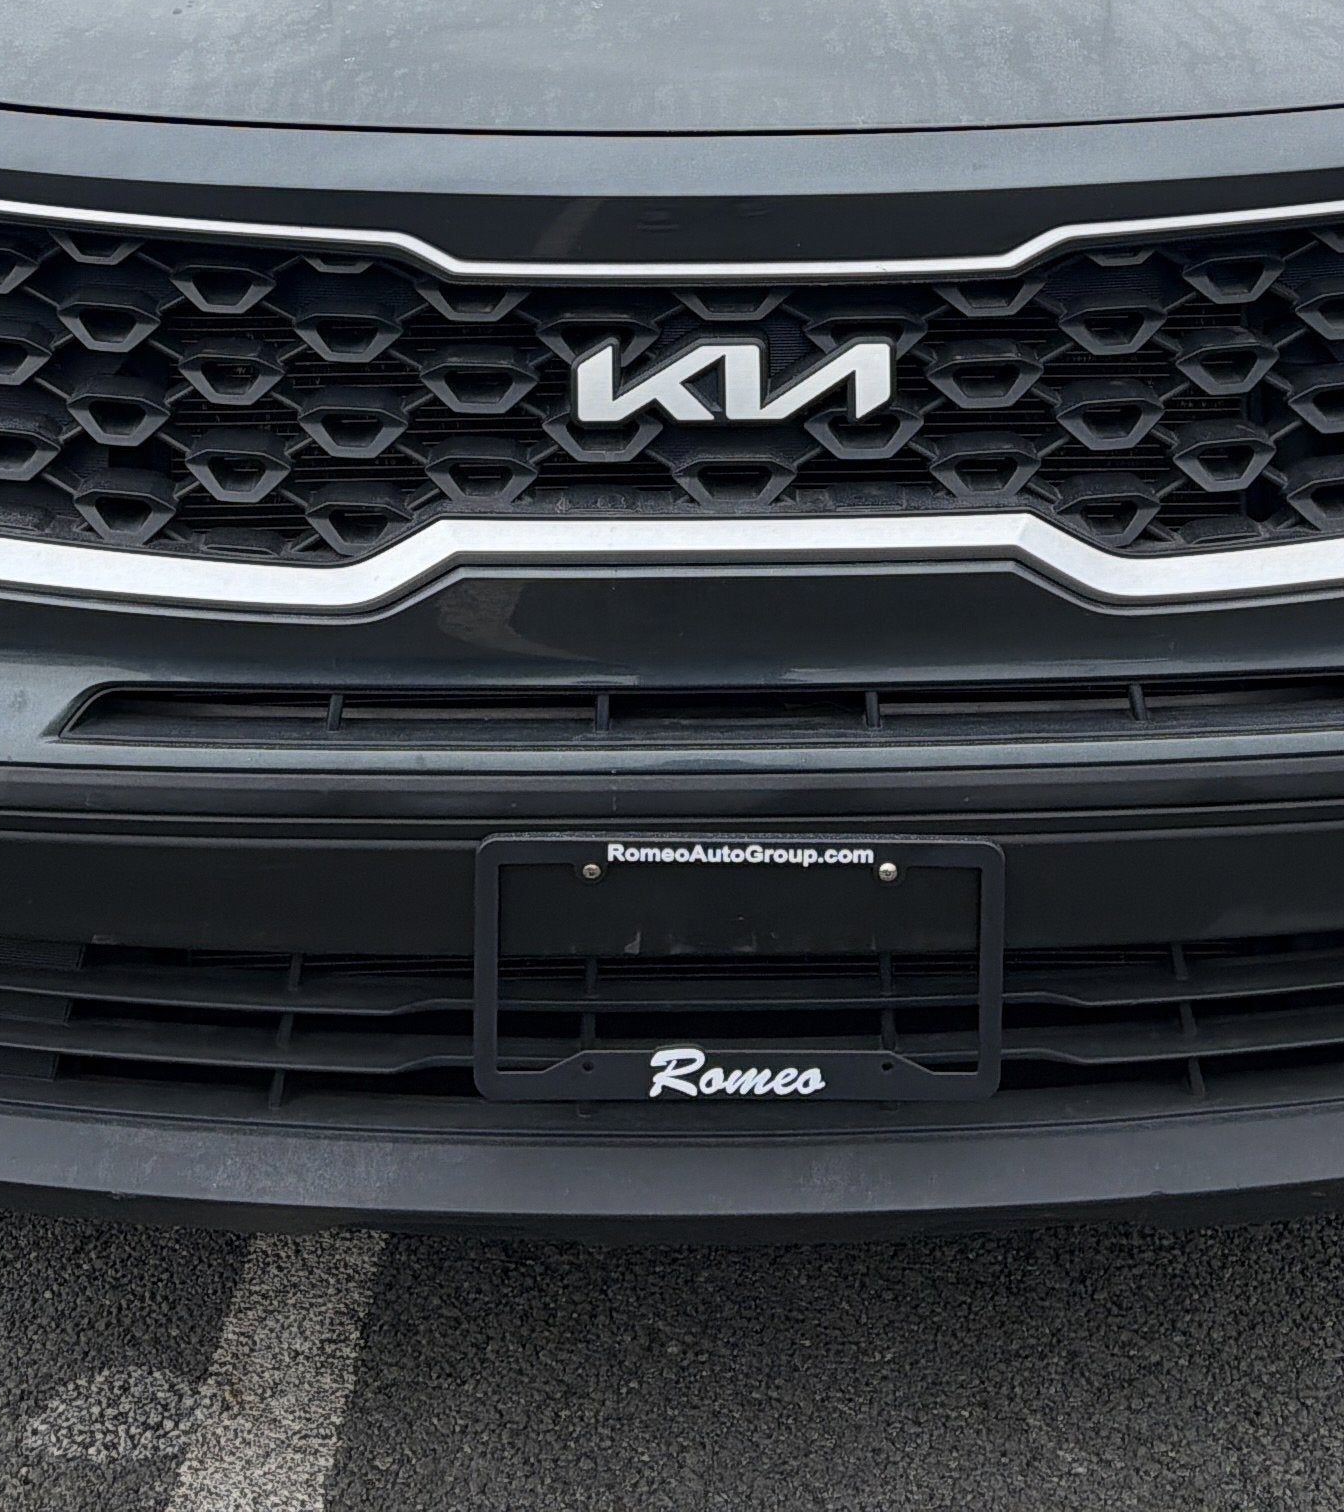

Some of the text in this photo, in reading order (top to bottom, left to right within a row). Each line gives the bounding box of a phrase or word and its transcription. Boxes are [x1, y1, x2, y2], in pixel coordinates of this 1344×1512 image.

[576, 343, 893, 422] KIA
[607, 843, 875, 867] RomeoAutoGroup.com
[649, 1048, 826, 1097] Romeo
